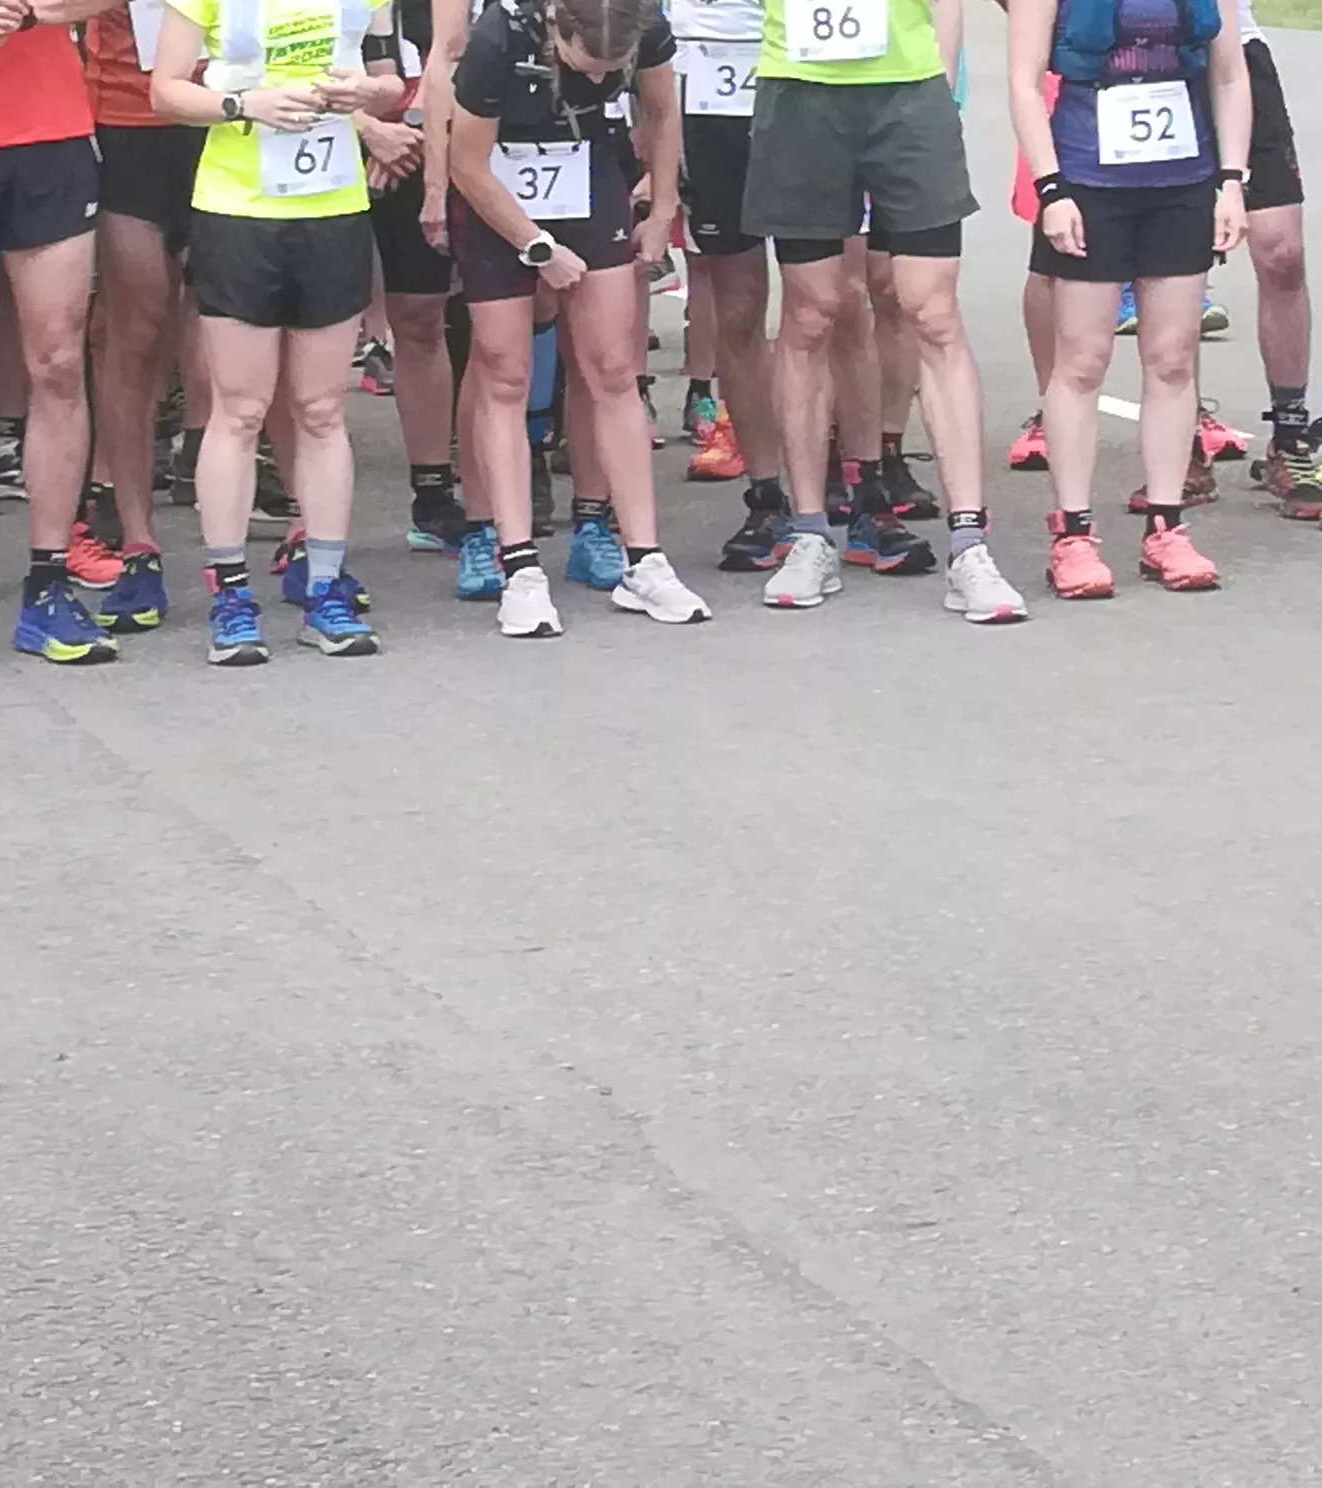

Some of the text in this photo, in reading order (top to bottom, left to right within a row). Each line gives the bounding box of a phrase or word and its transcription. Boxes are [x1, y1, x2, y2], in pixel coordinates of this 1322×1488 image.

[813, 6, 861, 41] 86
[1128, 106, 1176, 143] 52
[294, 136, 335, 175] 67
[516, 165, 562, 201] 37
